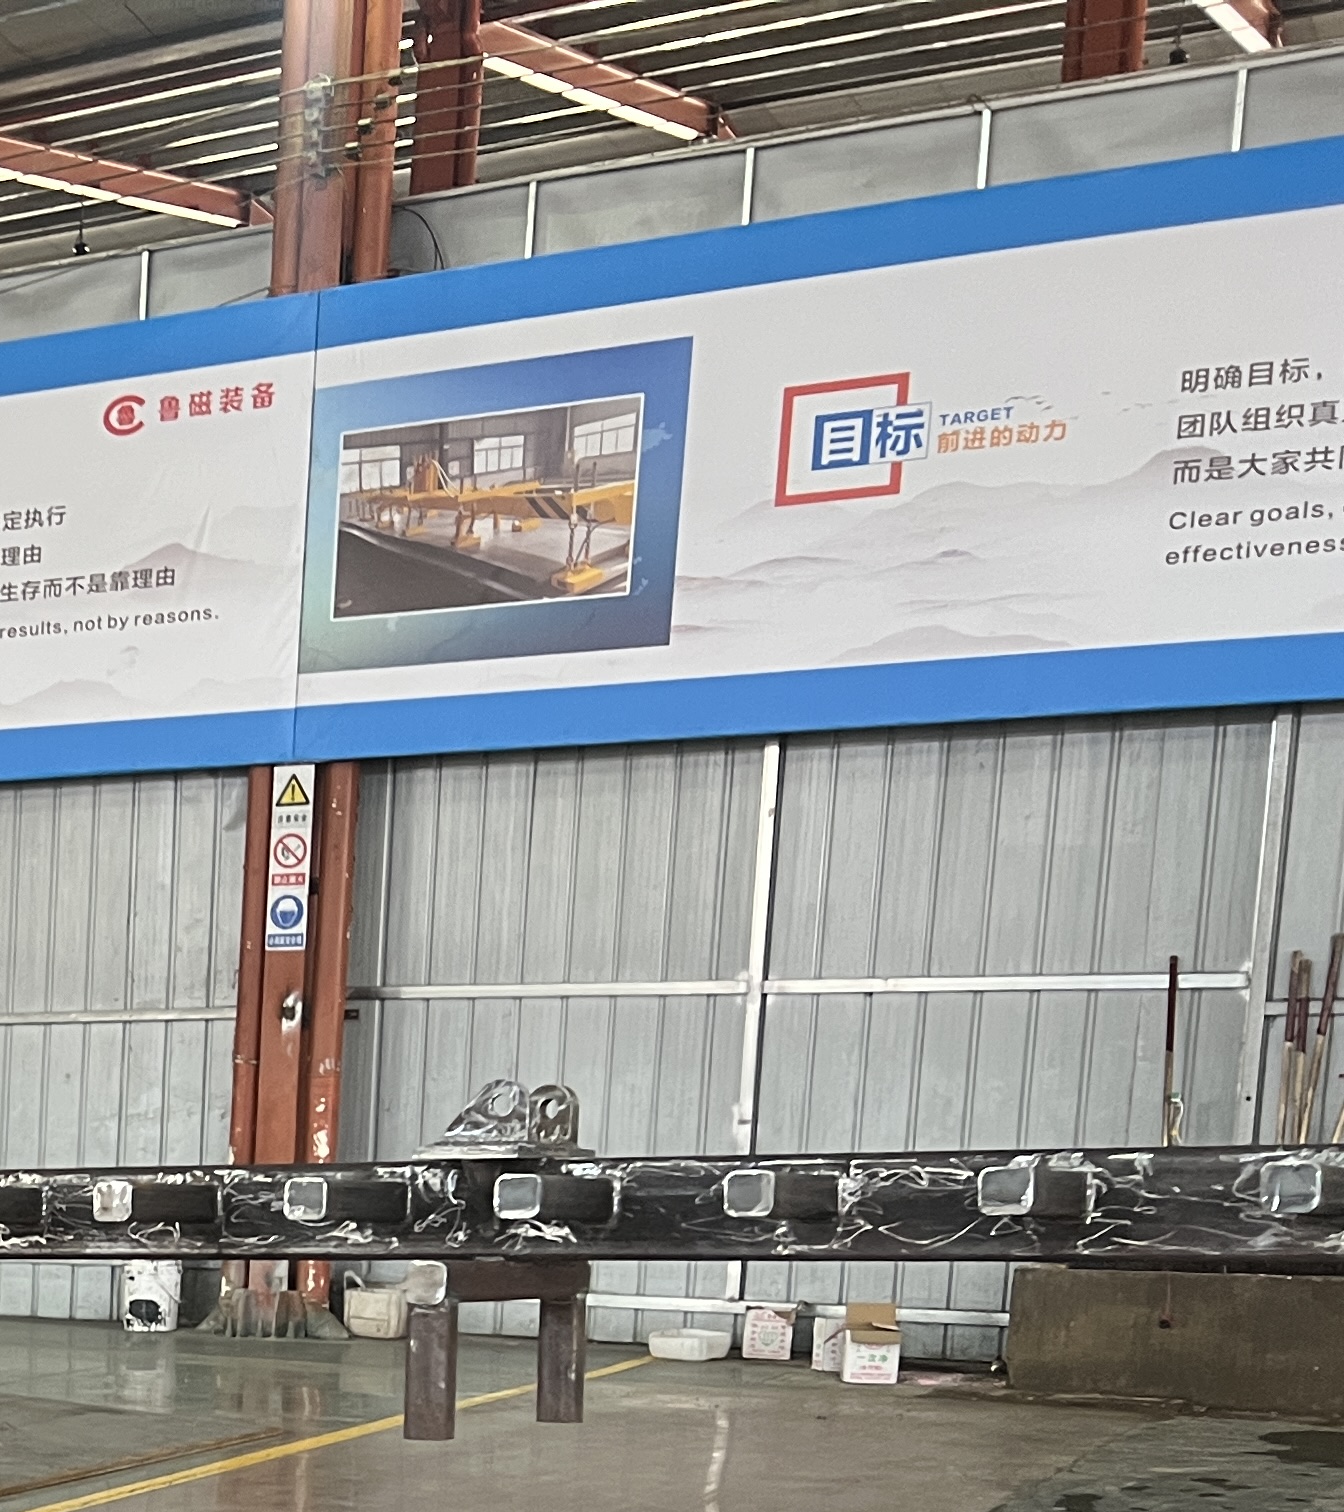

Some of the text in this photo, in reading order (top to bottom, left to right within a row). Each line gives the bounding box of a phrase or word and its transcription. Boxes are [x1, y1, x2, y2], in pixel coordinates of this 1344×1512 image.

[939, 406, 1015, 426] TARGET
[1176, 399, 1344, 440] 团队组织真
[820, 407, 926, 466] 目标
[936, 420, 1067, 454] 前进的动力
[1172, 445, 1344, 485] 而是大家共
[1168, 500, 1333, 530] Clear goals,
[0, 620, 68, 640] results,
[73, 616, 103, 632] not
[107, 614, 129, 631] by
[134, 607, 220, 627] reasons.
